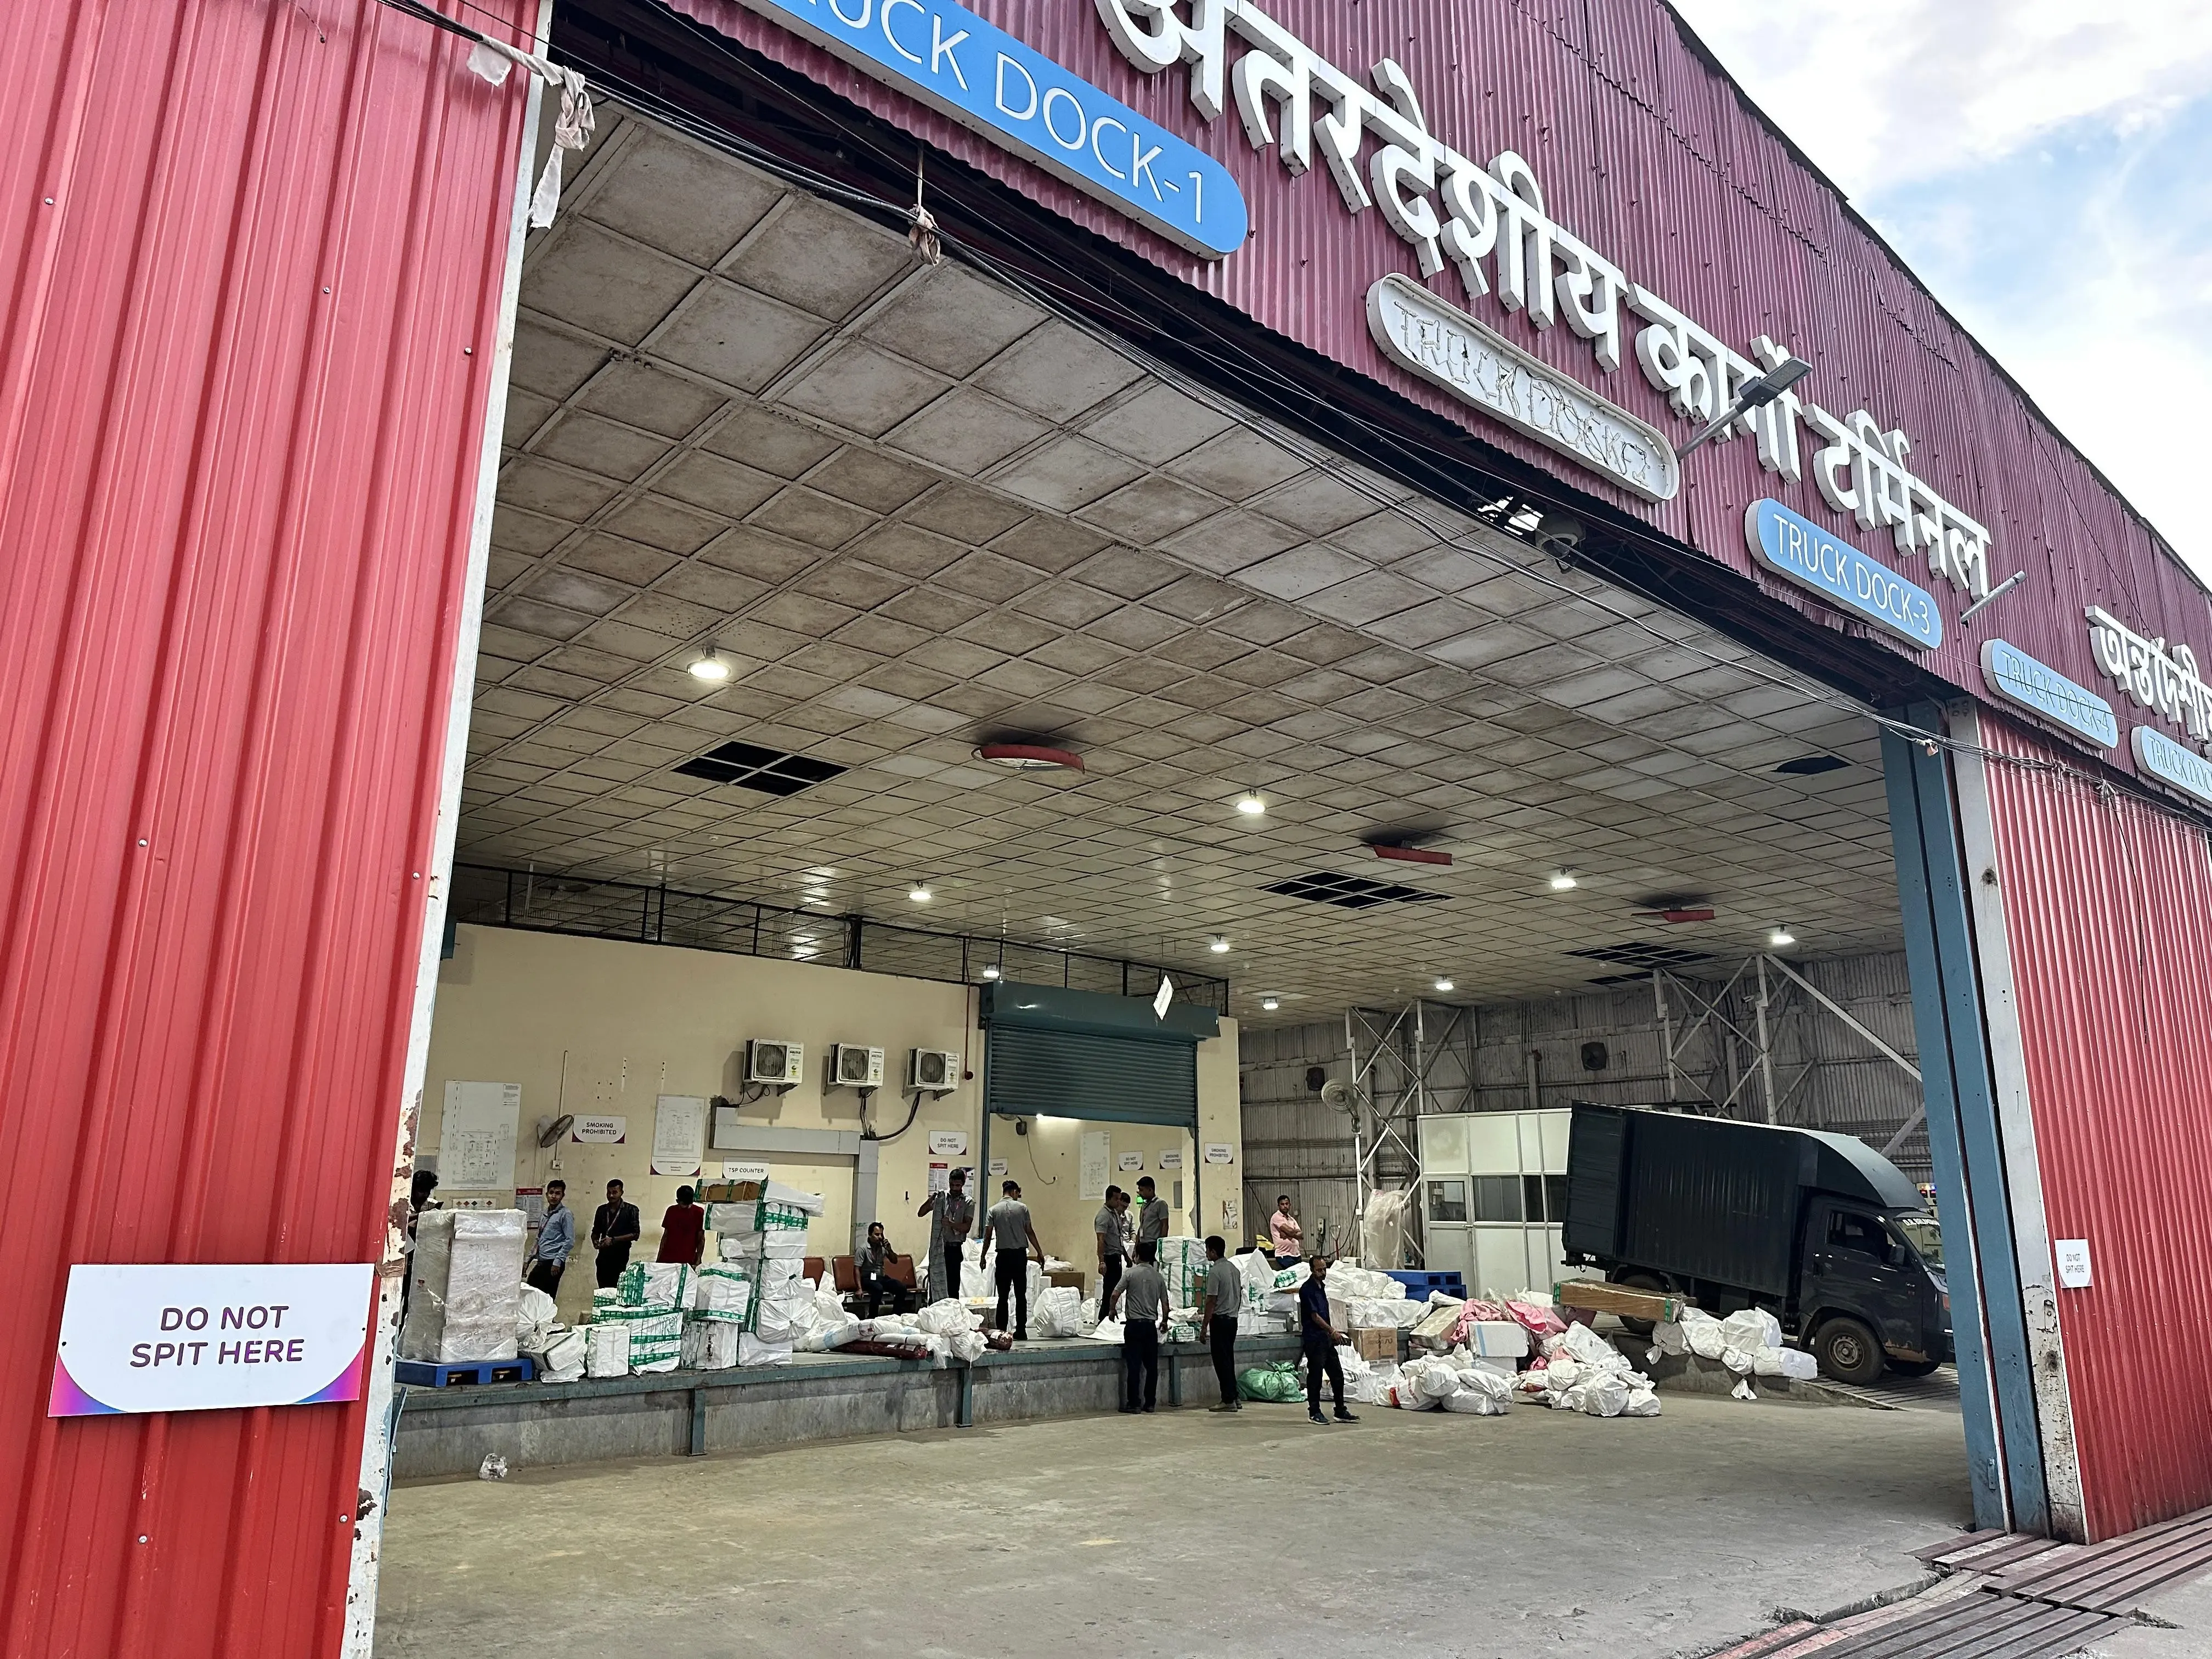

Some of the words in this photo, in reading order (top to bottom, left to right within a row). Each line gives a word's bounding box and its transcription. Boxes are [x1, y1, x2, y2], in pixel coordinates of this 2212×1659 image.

[995, 52, 1203, 224] DOCK-1
[1773, 513, 1850, 591] TRUCK
[1855, 561, 1931, 635] DOCK-3
[2001, 651, 2055, 708] TRUCK
[2056, 682, 2110, 737] DOCK-4
[2147, 736, 2189, 783] TRUCK
[2187, 758, 2212, 794] DOC
[2066, 1254, 2072, 1262] DO
[160, 1307, 209, 1331] DO
[220, 1305, 290, 1330] NOT
[129, 1341, 209, 1368] SPIT
[218, 1339, 305, 1365] HERE
